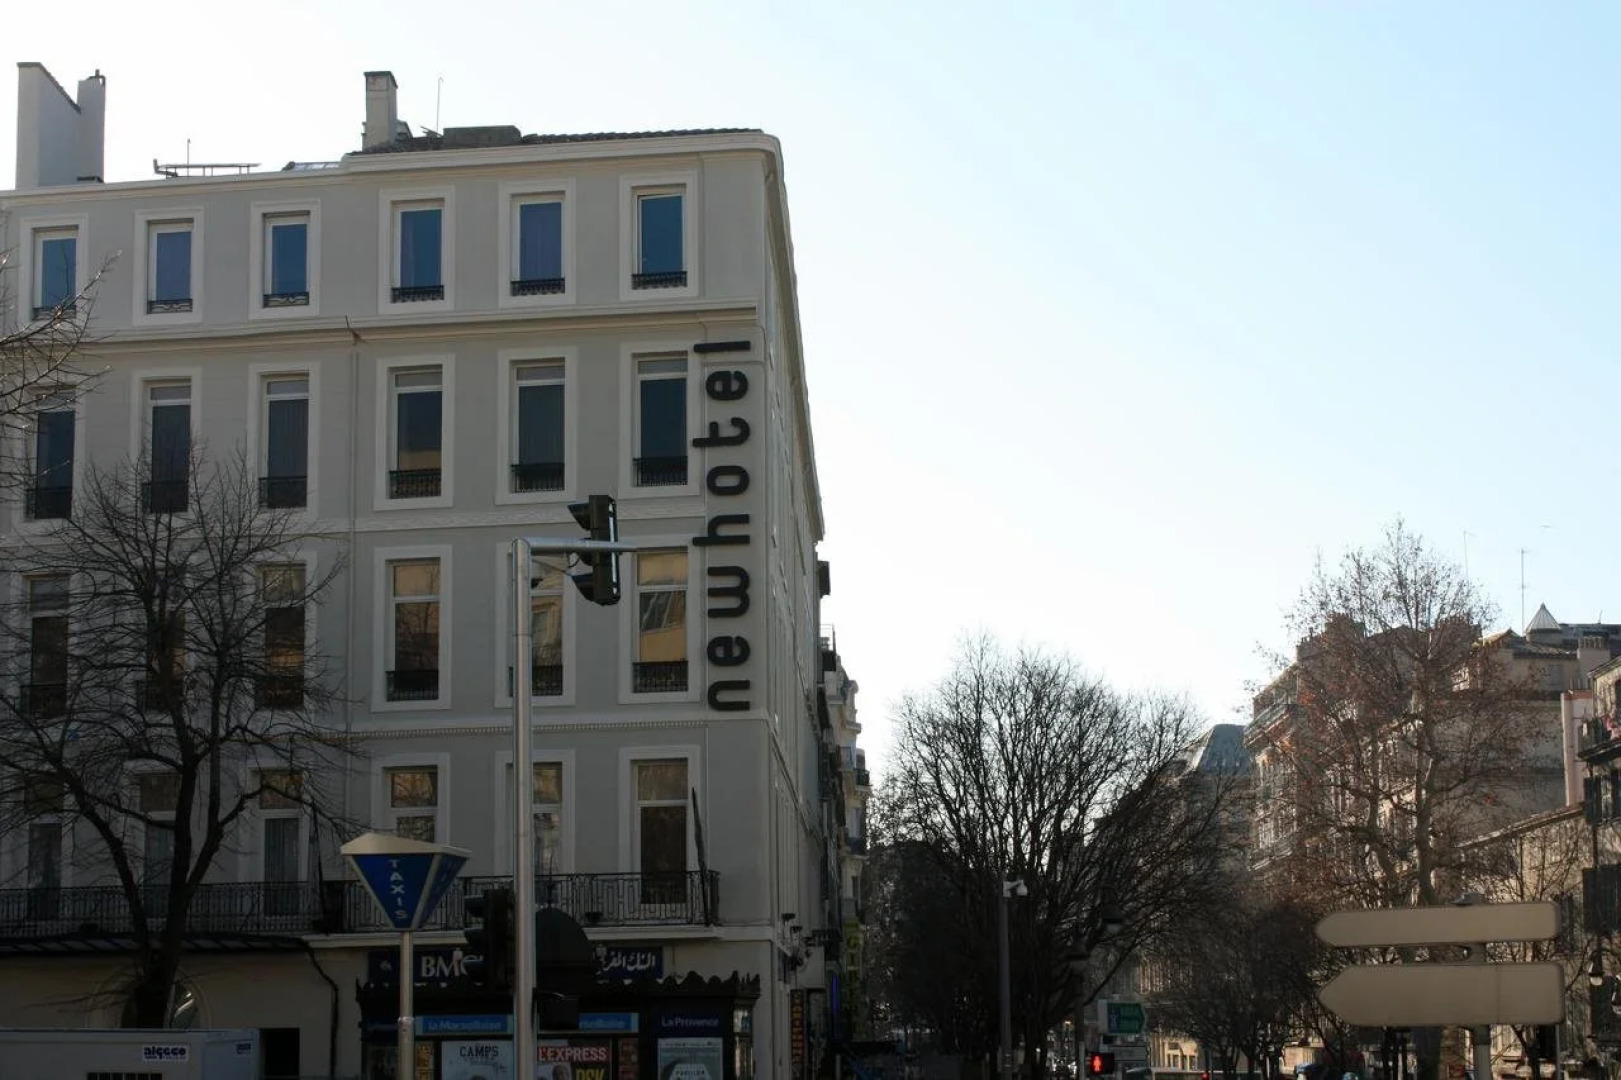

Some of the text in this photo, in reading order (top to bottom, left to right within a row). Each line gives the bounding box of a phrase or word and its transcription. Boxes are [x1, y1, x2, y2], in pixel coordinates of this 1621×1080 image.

[388, 859, 408, 919] TAXIS
[459, 1045, 499, 1058] CAMPS
[538, 1046, 608, 1062] L'EXPRESS
